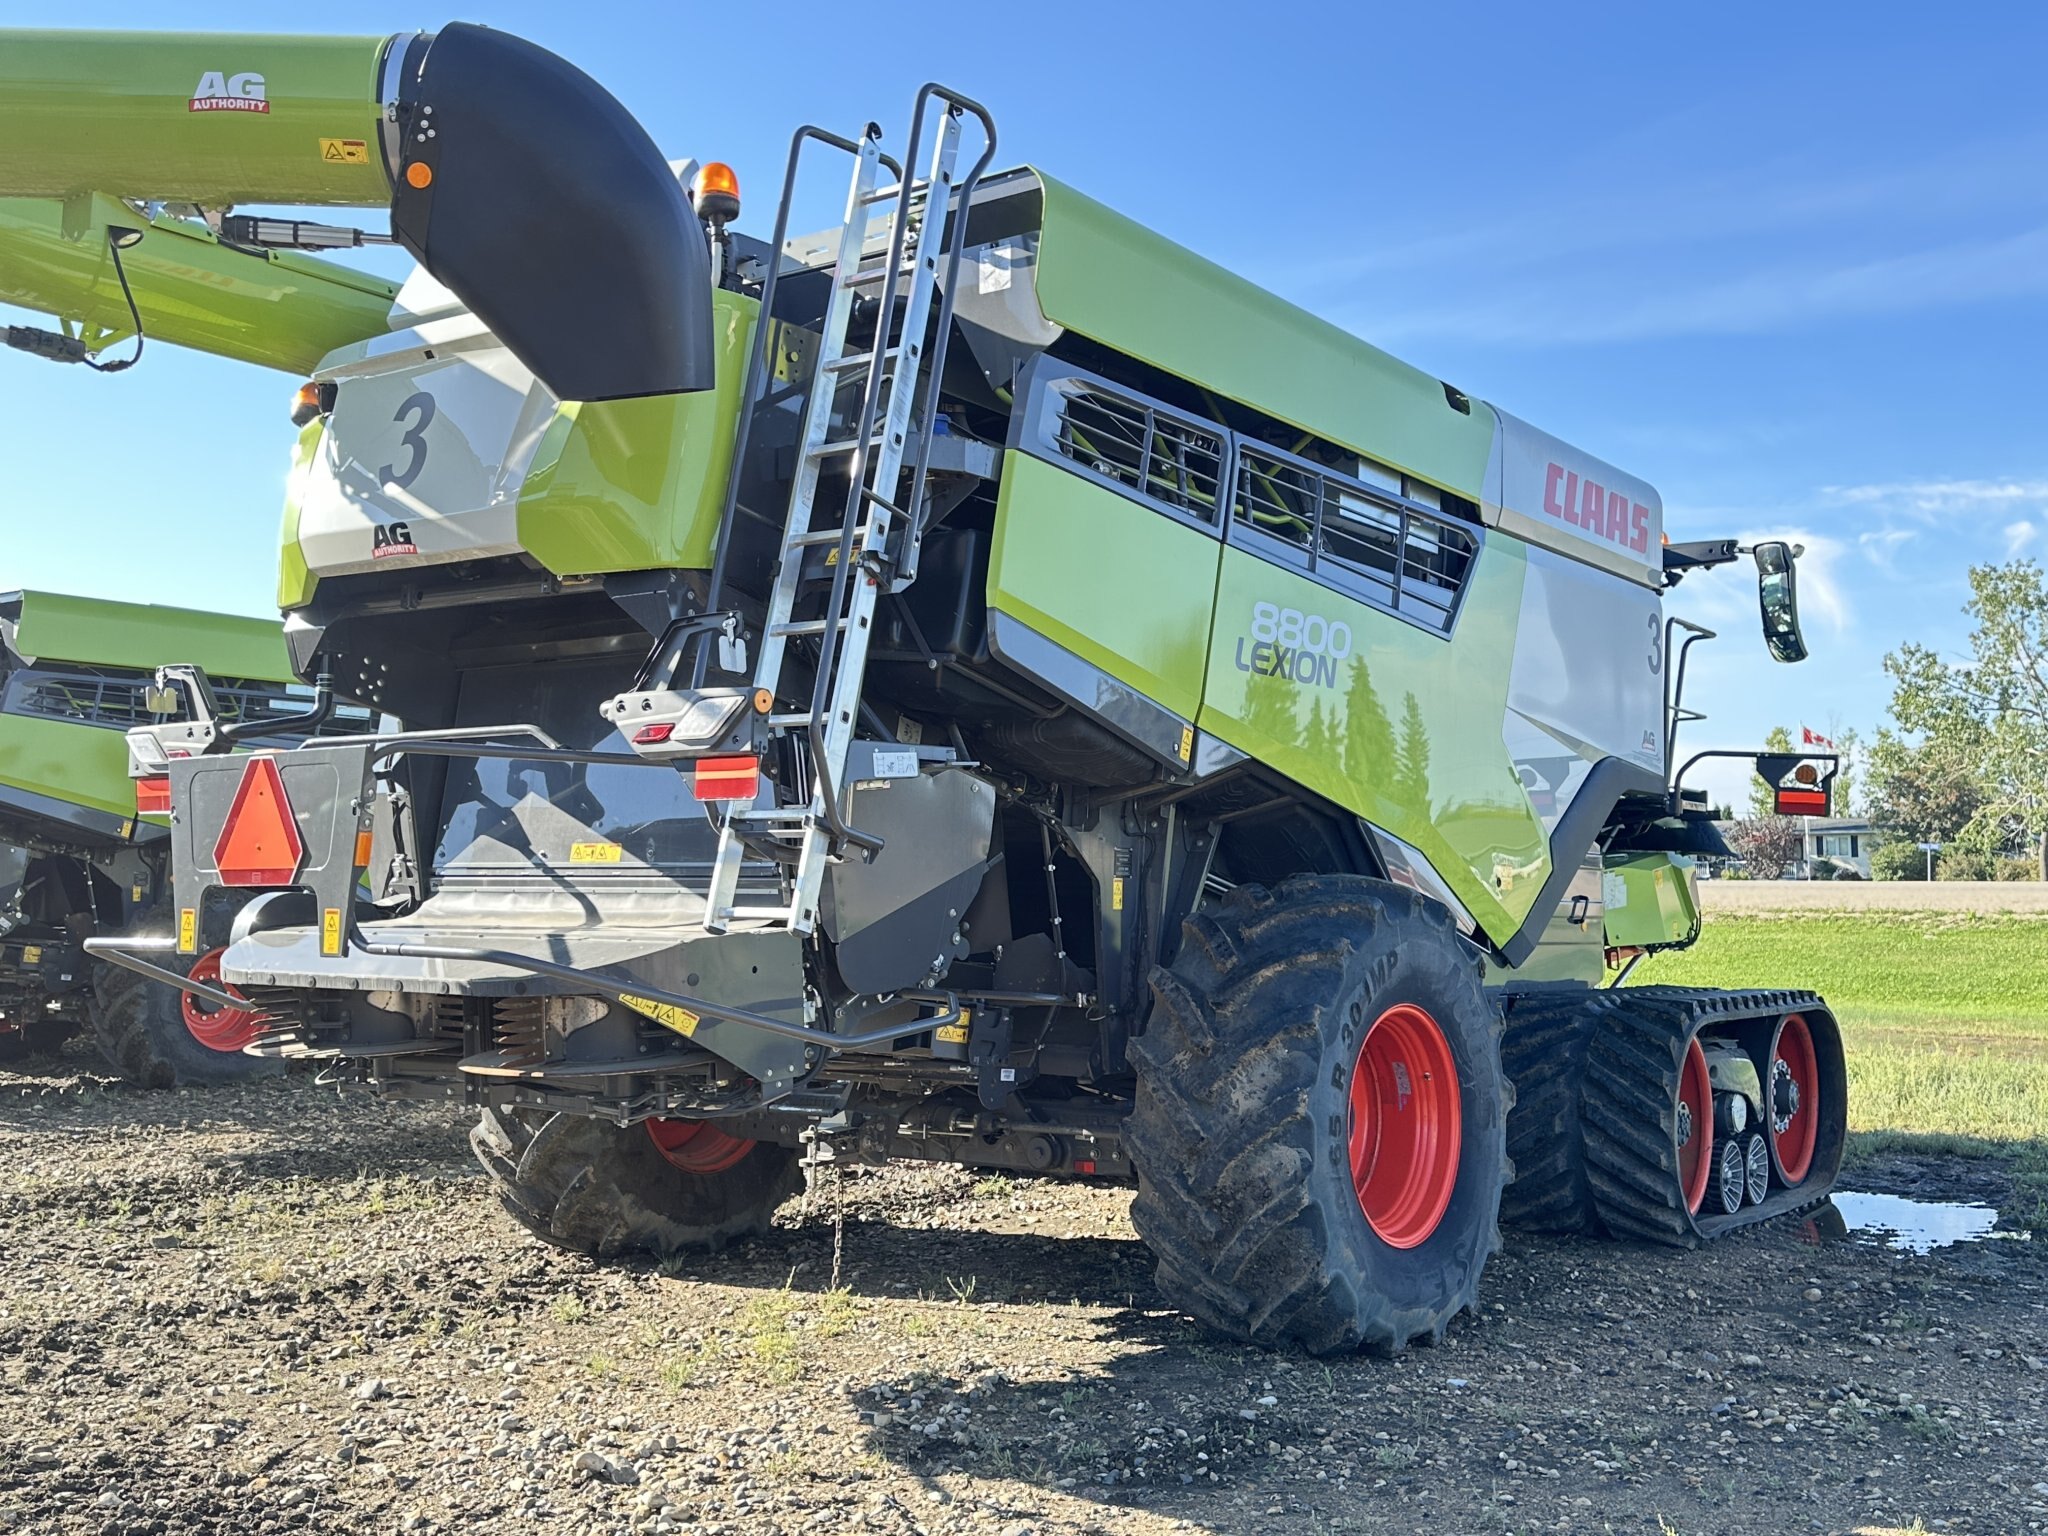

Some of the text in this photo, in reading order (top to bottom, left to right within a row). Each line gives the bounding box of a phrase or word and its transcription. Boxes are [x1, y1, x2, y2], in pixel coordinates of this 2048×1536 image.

[192, 71, 266, 101] AG
[192, 98, 267, 112] AUTHORITY
[379, 391, 436, 492] 3
[1543, 462, 1649, 554] CLAAS
[373, 521, 413, 549] AG
[373, 544, 415, 558] AUTHORITY
[1251, 601, 1352, 659] 8800
[1647, 613, 1662, 675] 3
[1235, 636, 1338, 689] LEXION
[1642, 729, 1656, 747] AG
[1330, 1062, 1347, 1092] R
